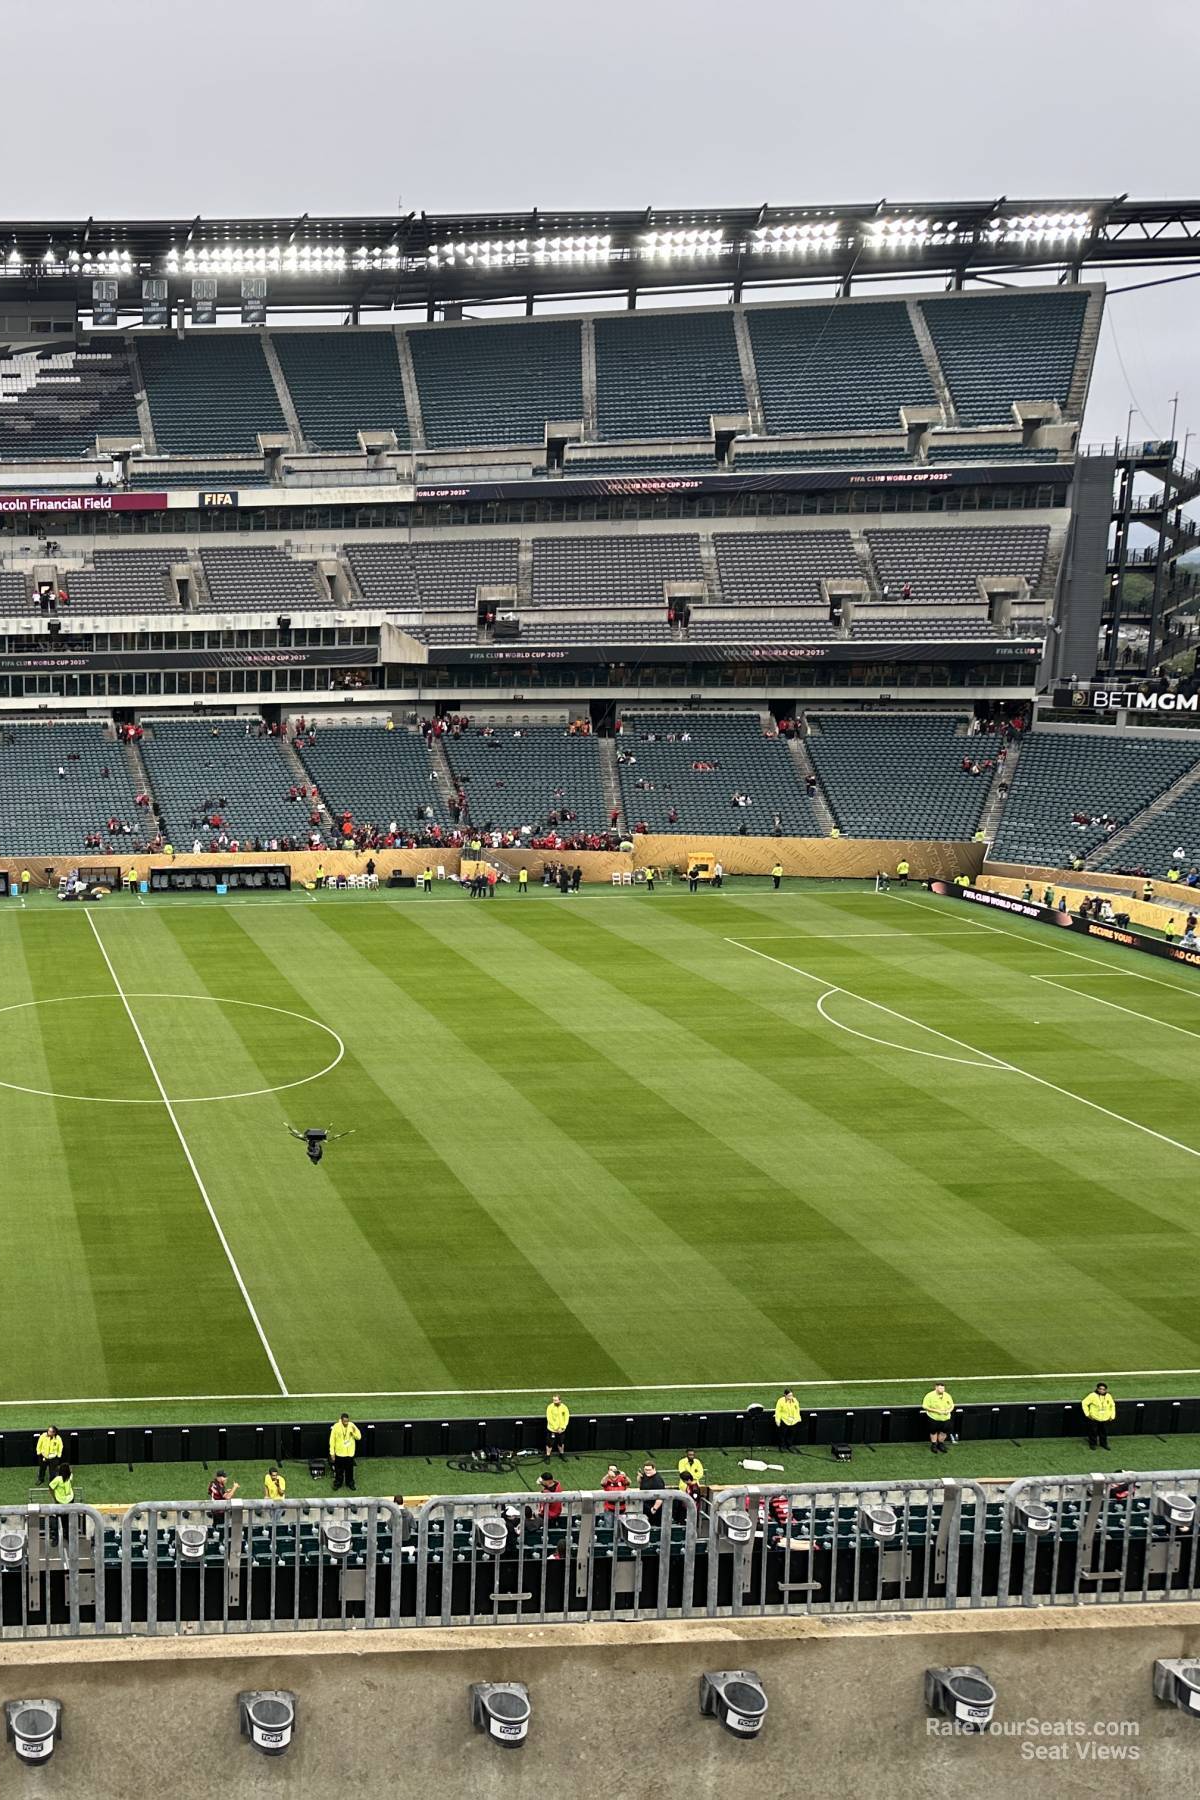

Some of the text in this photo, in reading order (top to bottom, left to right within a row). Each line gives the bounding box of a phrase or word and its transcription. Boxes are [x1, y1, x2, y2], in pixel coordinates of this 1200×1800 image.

[94, 281, 116, 301] 15
[144, 280, 166, 300] 40
[193, 280, 216, 300] 99
[242, 279, 265, 298] 20
[30, 498, 81, 510] Financial
[84, 497, 112, 509] Field
[204, 494, 233, 506] FIFA
[1093, 691, 1198, 711] BETMGM
[962, 890, 975, 899] FIFA
[975, 893, 990, 904] CLUB
[990, 896, 1010, 909] WORLD
[1011, 902, 1022, 912] CUP
[1089, 925, 1113, 939] SECURE
[1113, 930, 1132, 944] YOUR
[263, 1734, 282, 1742] TORK
